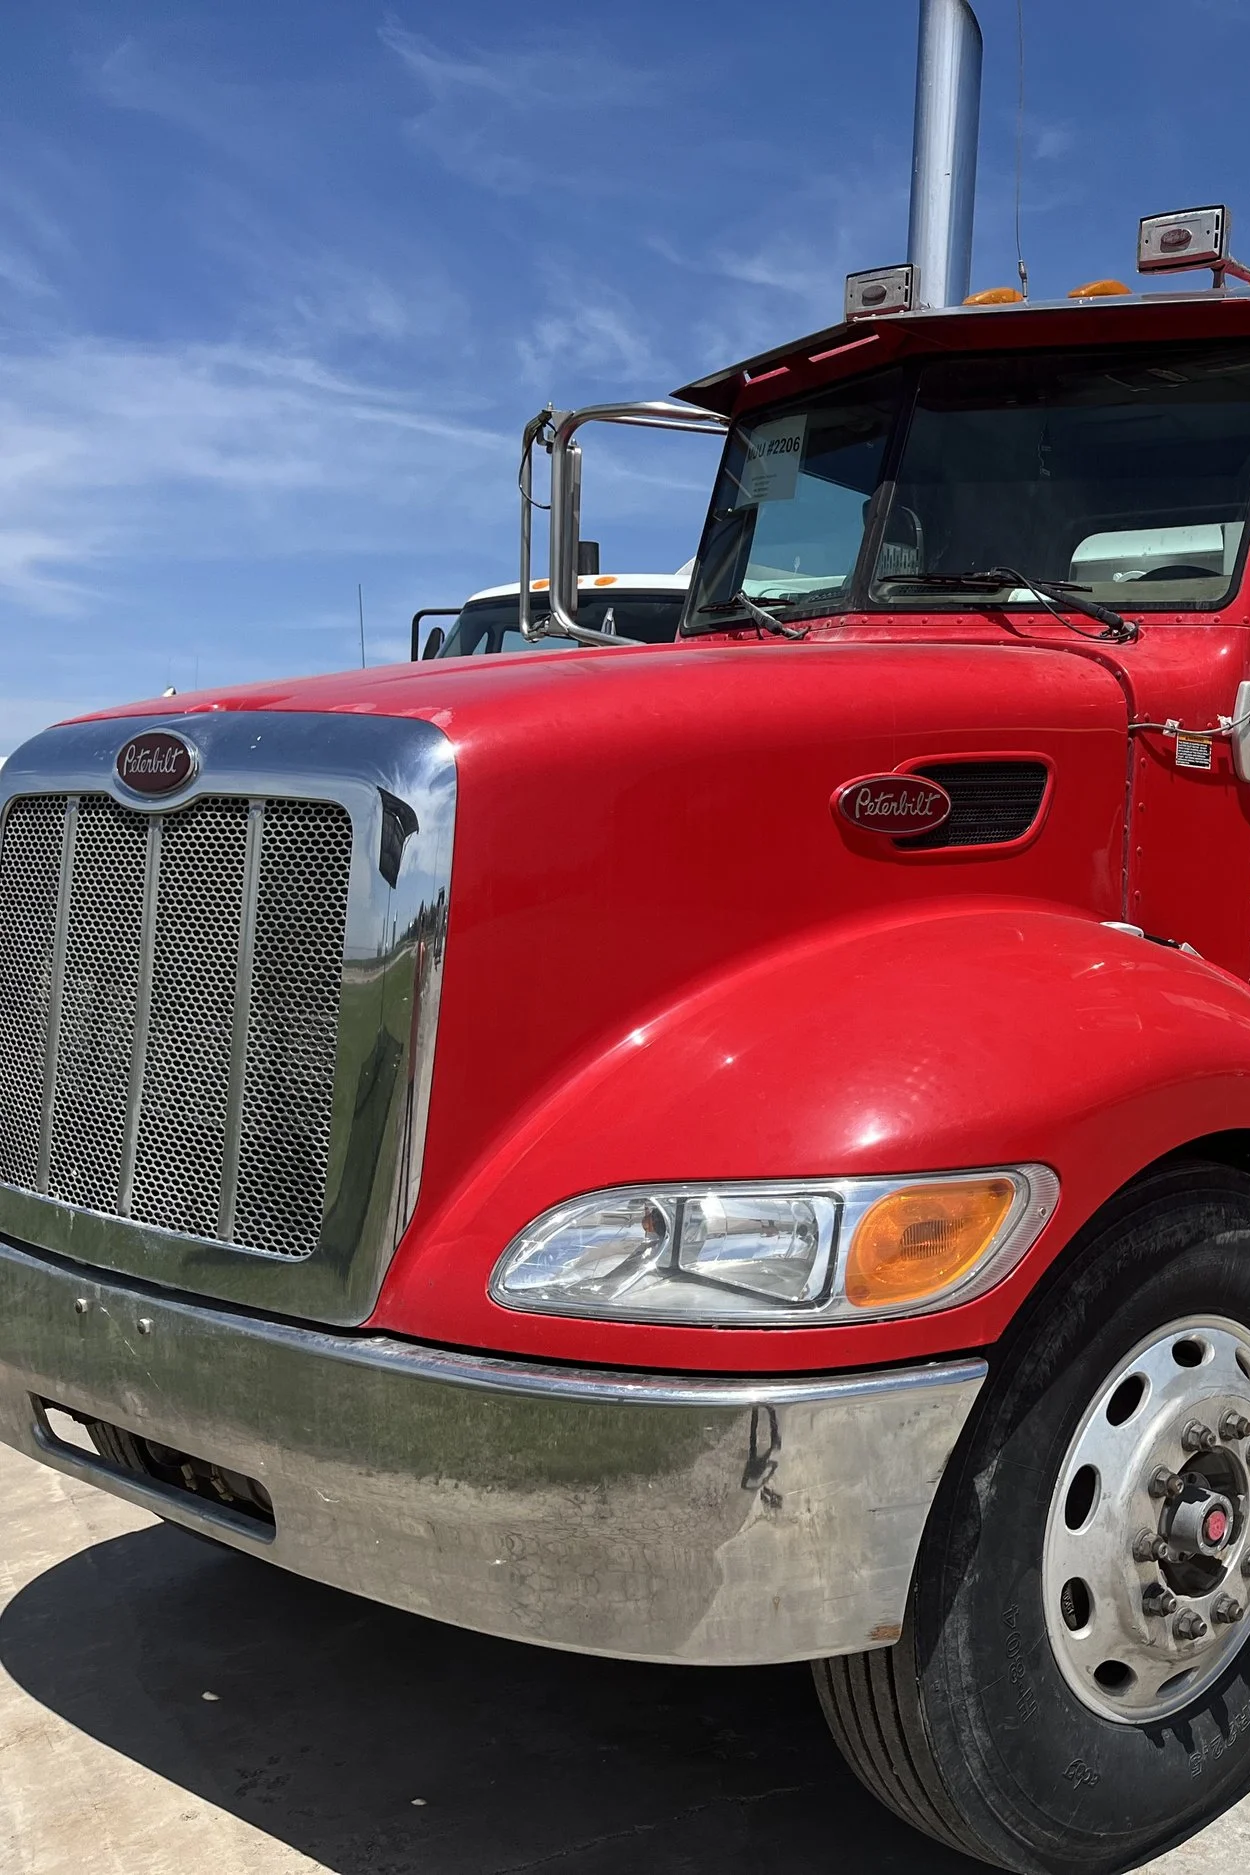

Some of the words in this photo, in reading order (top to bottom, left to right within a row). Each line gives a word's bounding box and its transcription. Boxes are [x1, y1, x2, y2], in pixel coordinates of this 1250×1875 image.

[767, 436, 800, 456] #2206
[123, 744, 184, 776] Peterbilt
[854, 787, 941, 819] Peterbilt
